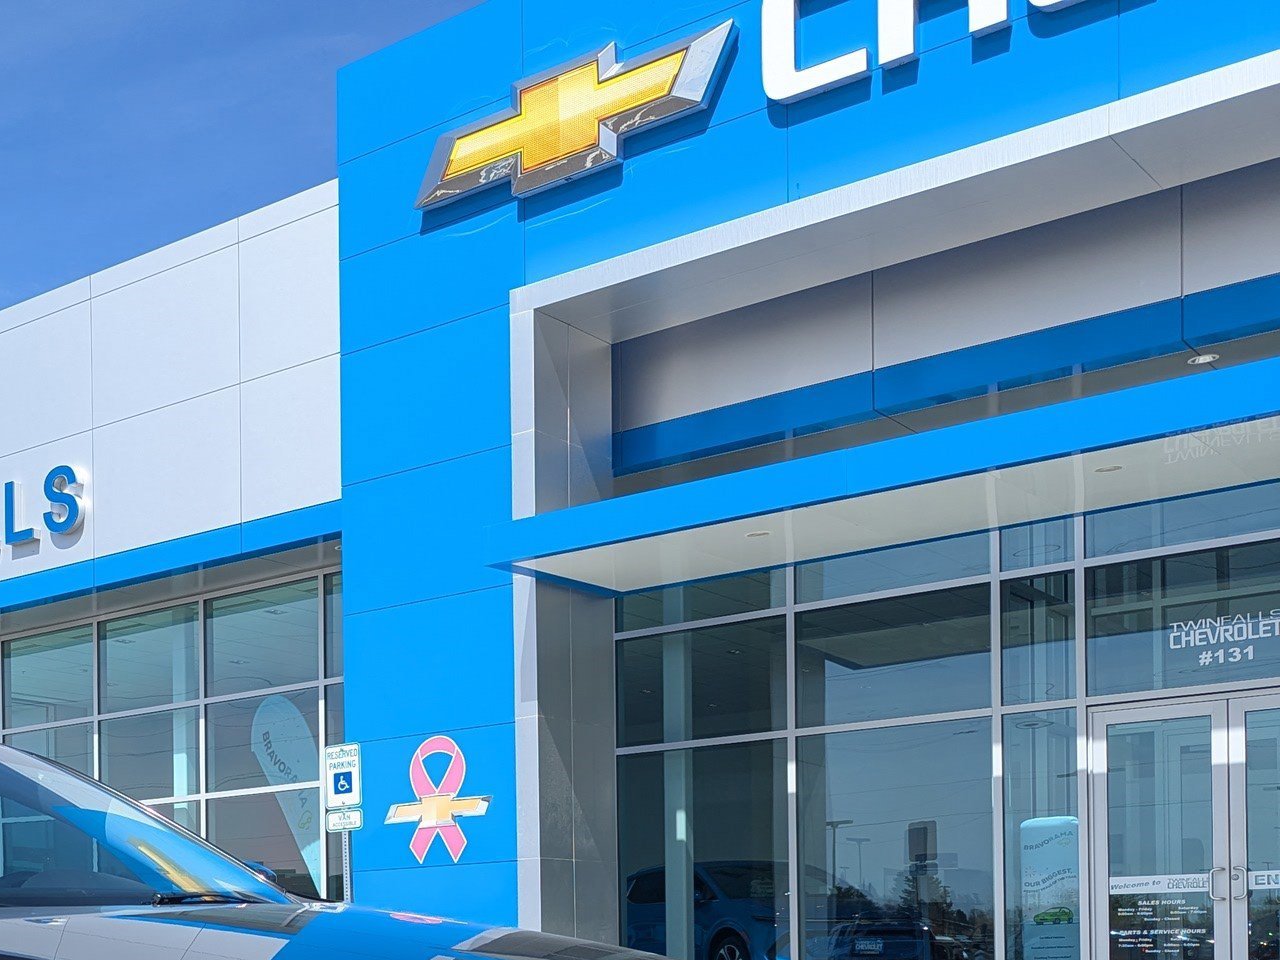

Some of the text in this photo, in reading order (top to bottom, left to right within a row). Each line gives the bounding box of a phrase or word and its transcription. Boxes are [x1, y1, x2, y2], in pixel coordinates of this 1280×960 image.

[1169, 619, 1280, 649] CHEVROLET
[1199, 645, 1254, 666] #131
[326, 748, 358, 760] RESERVED
[262, 731, 308, 808] BRAVORAA
[328, 759, 357, 771] PARKING
[1110, 881, 1150, 890] Welcome
